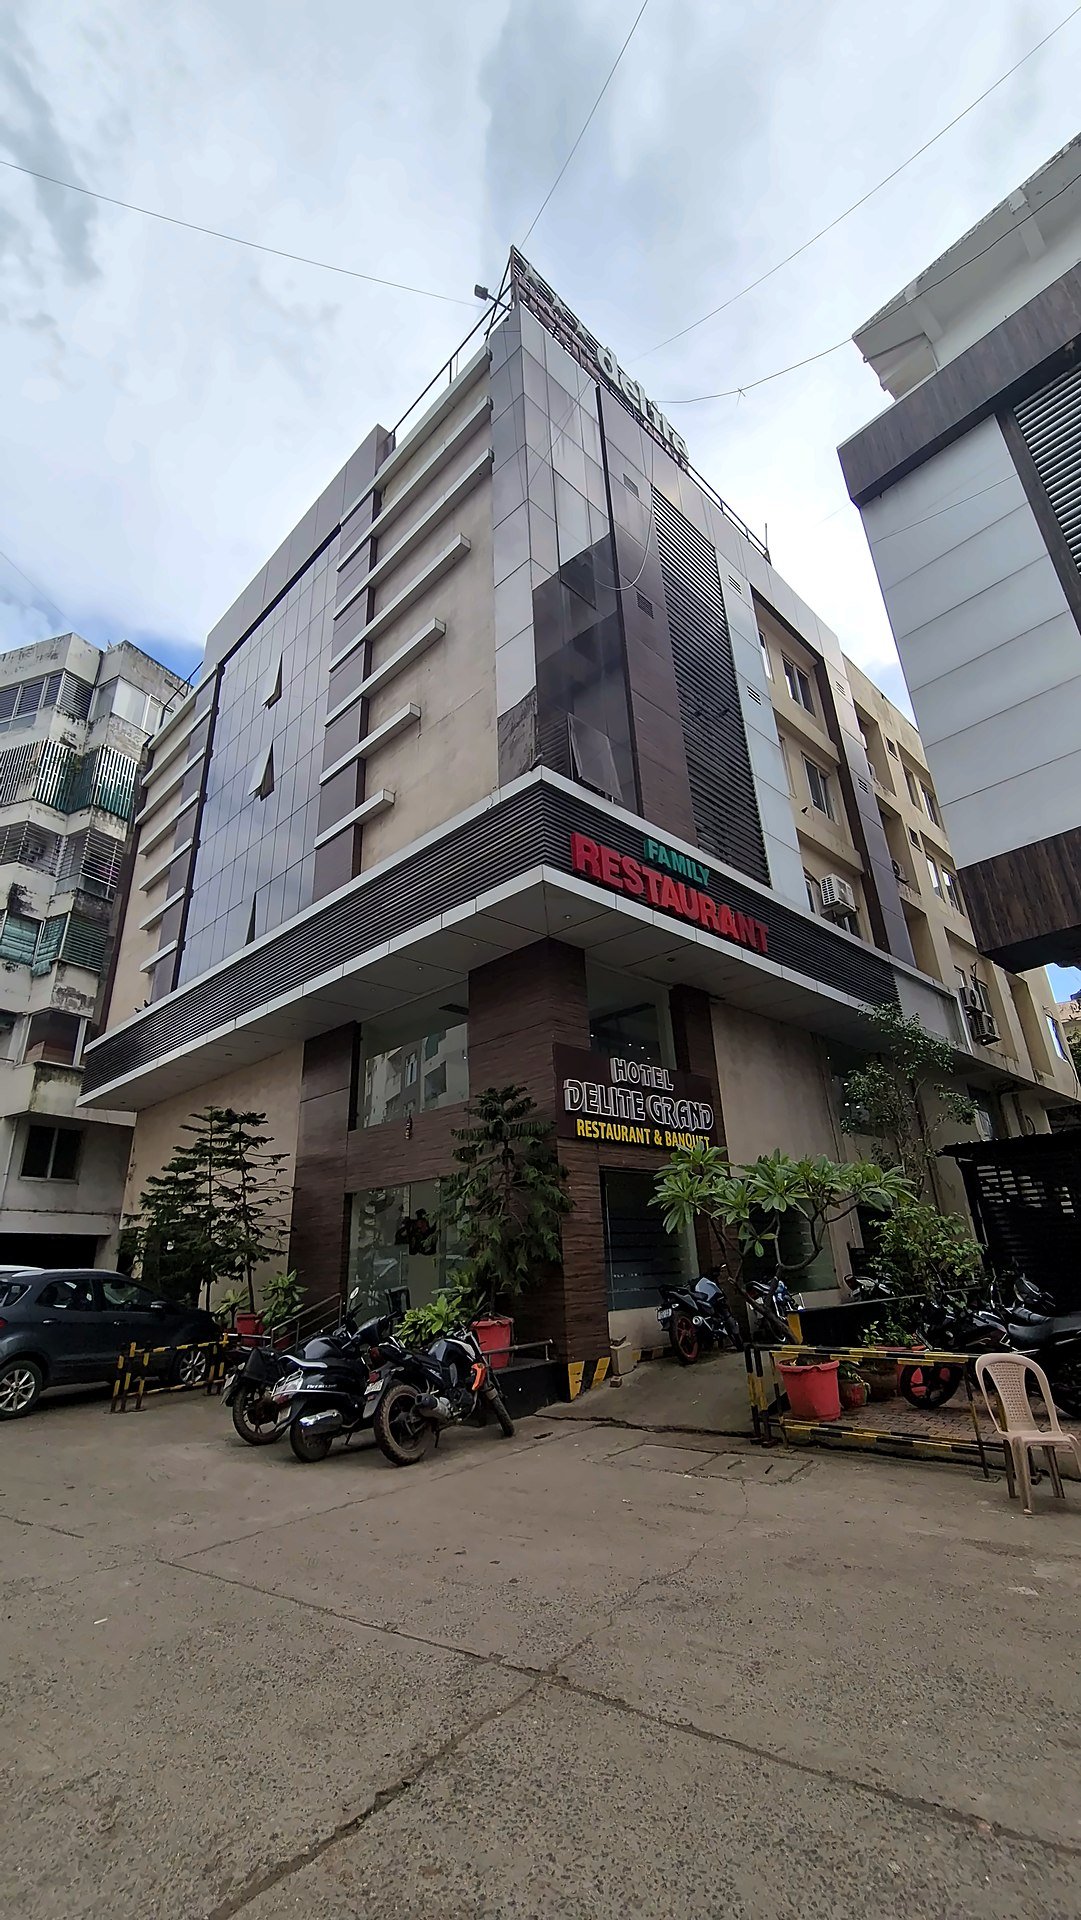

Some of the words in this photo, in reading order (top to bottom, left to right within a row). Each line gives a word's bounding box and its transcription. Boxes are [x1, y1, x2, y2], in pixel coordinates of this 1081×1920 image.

[597, 346, 690, 460] delite
[645, 838, 710, 887] FAMILY
[570, 832, 769, 952] RESTAURANT
[610, 1057, 674, 1091] HOTEL
[564, 1079, 645, 1121] DELITE
[646, 1095, 714, 1131] GRAND
[577, 1119, 651, 1144] RESTAURANT
[653, 1129, 663, 1146] &
